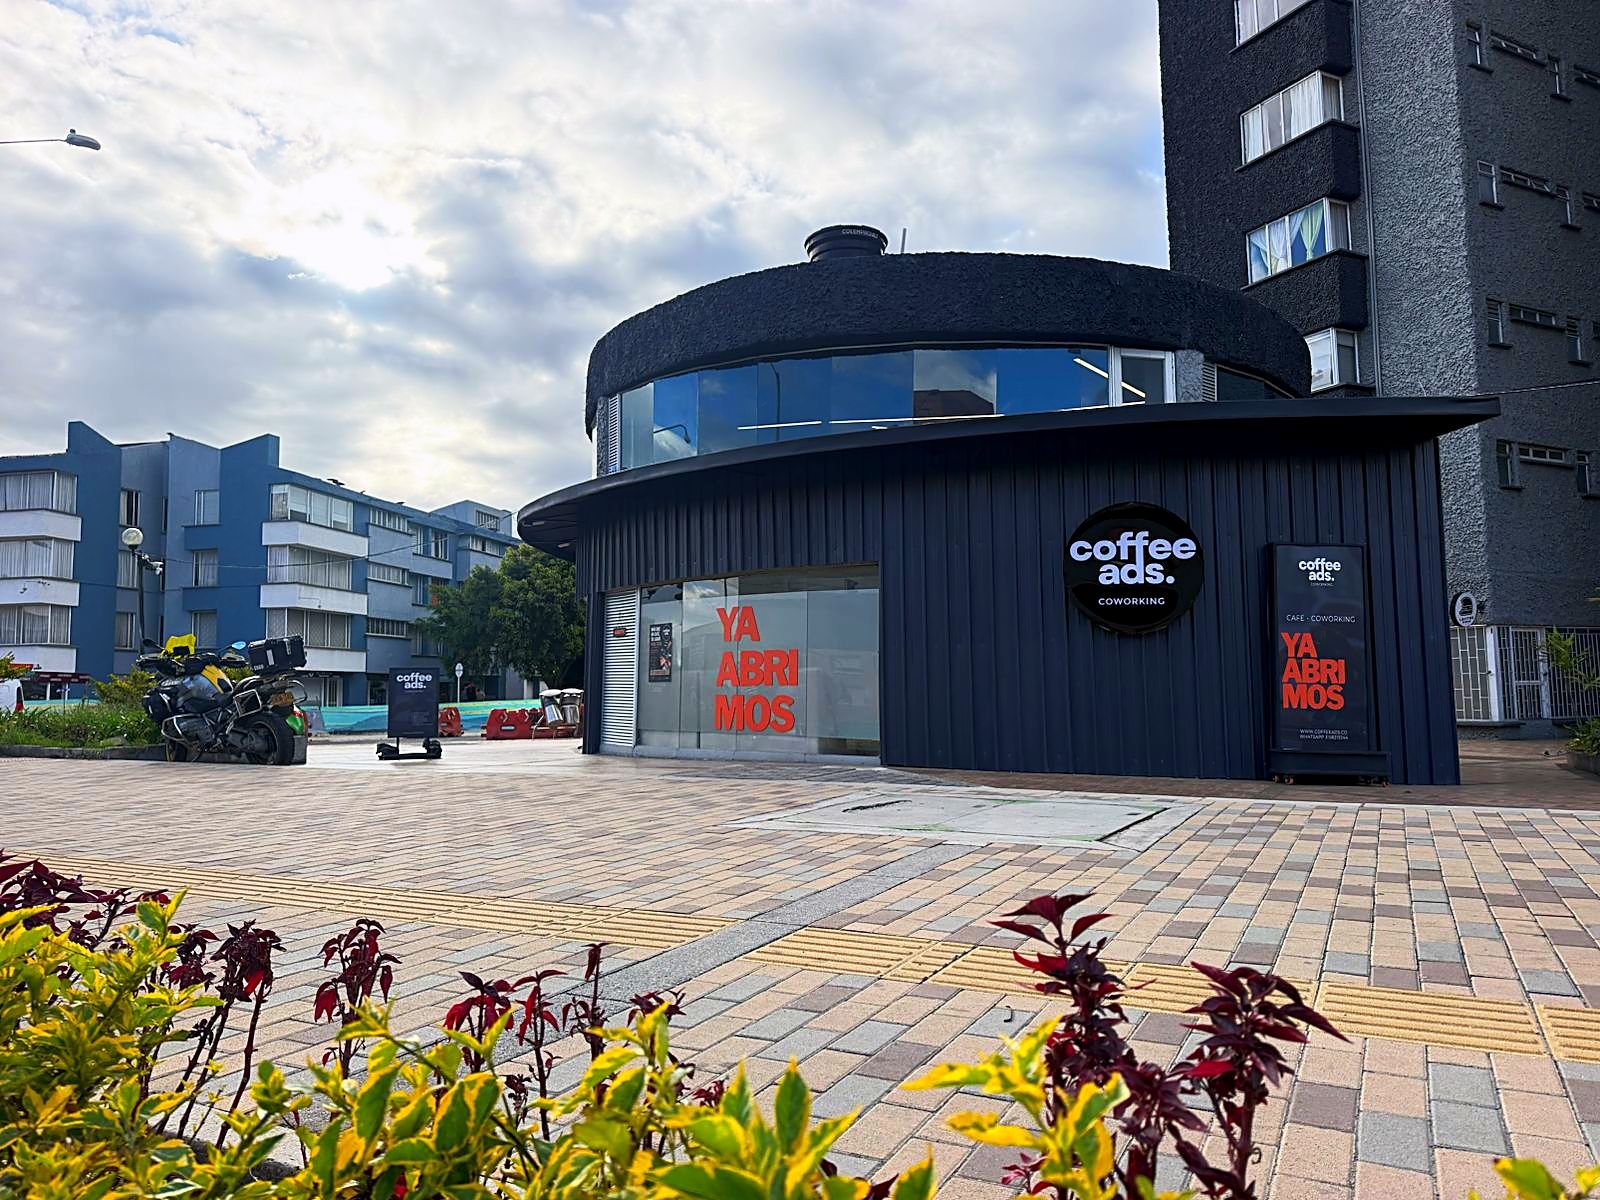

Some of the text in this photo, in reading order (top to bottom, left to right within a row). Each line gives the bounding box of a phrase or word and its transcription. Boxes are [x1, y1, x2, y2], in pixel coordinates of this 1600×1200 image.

[1069, 530, 1197, 562] coffee
[1098, 562, 1176, 585] ads.
[1298, 557, 1342, 571] coffee
[1308, 570, 1335, 582] ads.
[1098, 597, 1166, 606] COWORKING
[716, 606, 760, 642] YA
[1310, 615, 1356, 623] COWORKING
[1281, 632, 1317, 658] YA
[396, 672, 432, 682] coffee
[716, 648, 799, 688] ABRI
[1282, 658, 1346, 684] ABRI
[404, 681, 427, 689] ads.
[1282, 684, 1345, 711] MOS
[713, 694, 796, 733] MOS
